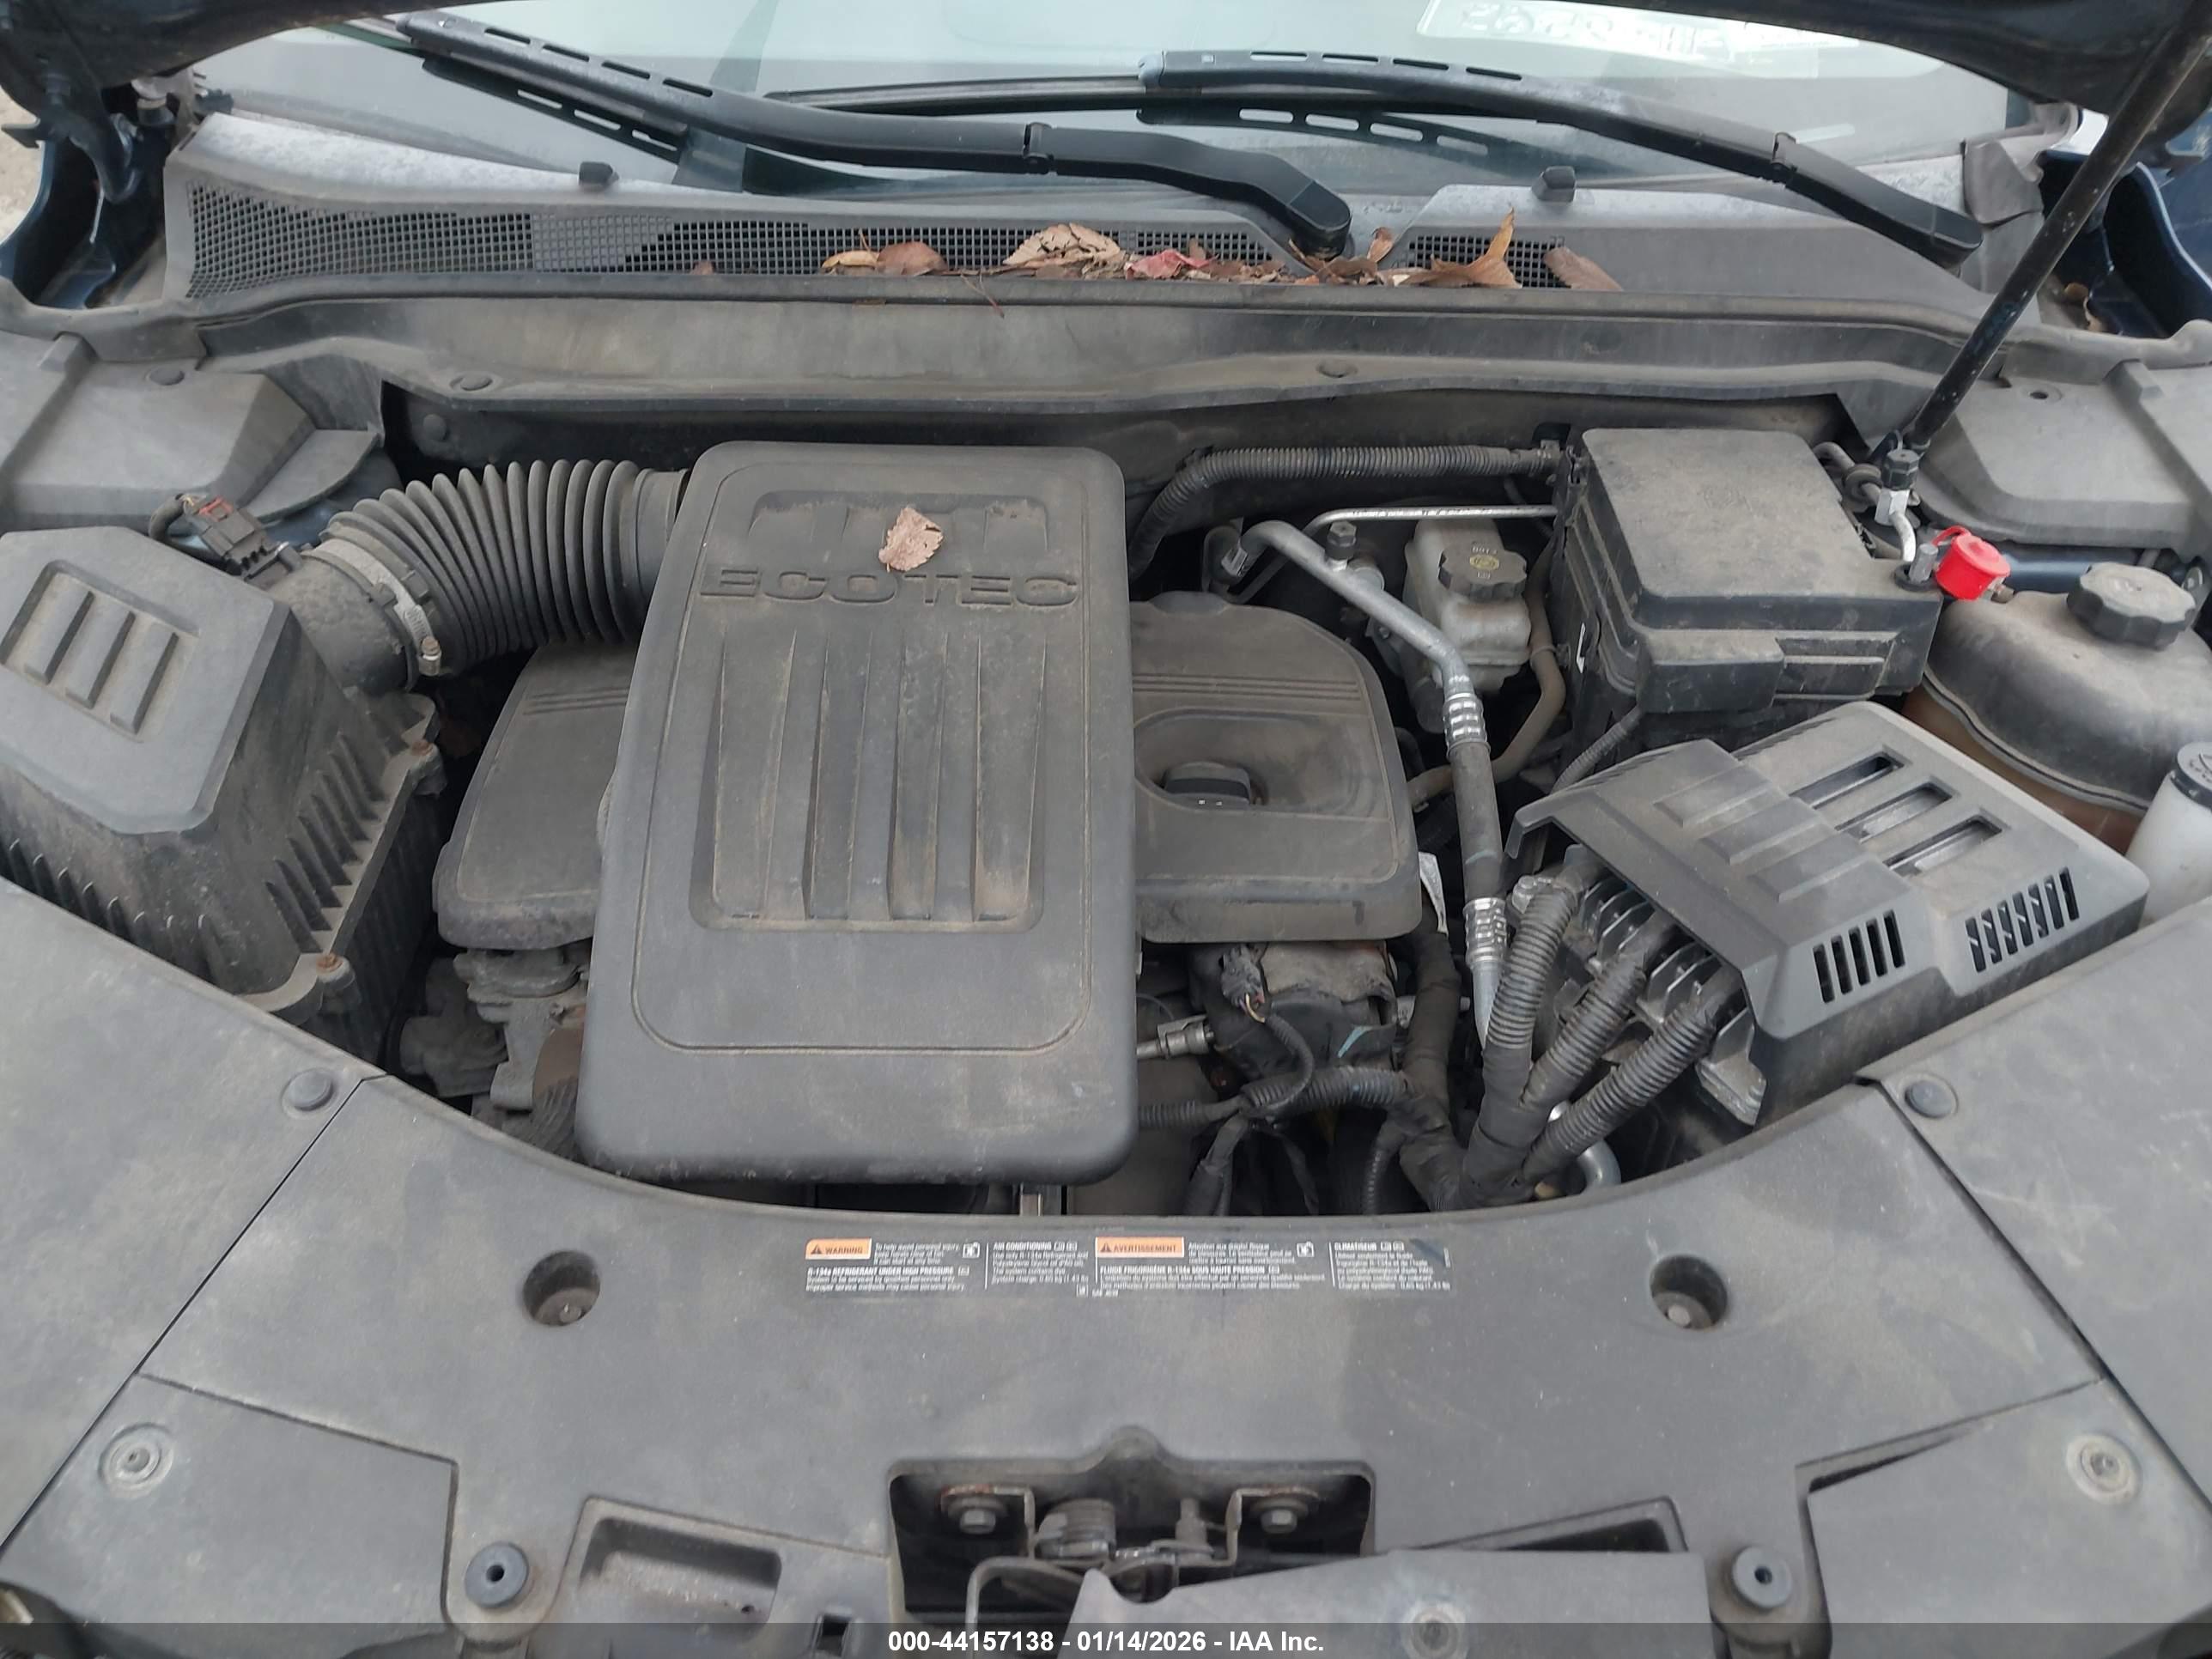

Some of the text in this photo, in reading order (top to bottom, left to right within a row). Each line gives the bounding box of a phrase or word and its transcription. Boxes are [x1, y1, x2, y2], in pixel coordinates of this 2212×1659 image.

[699, 564, 1078, 607] ECOTEC
[825, 1246, 863, 1255] WARNING
[1114, 1243, 1176, 1253] AVERTISSEMENT
